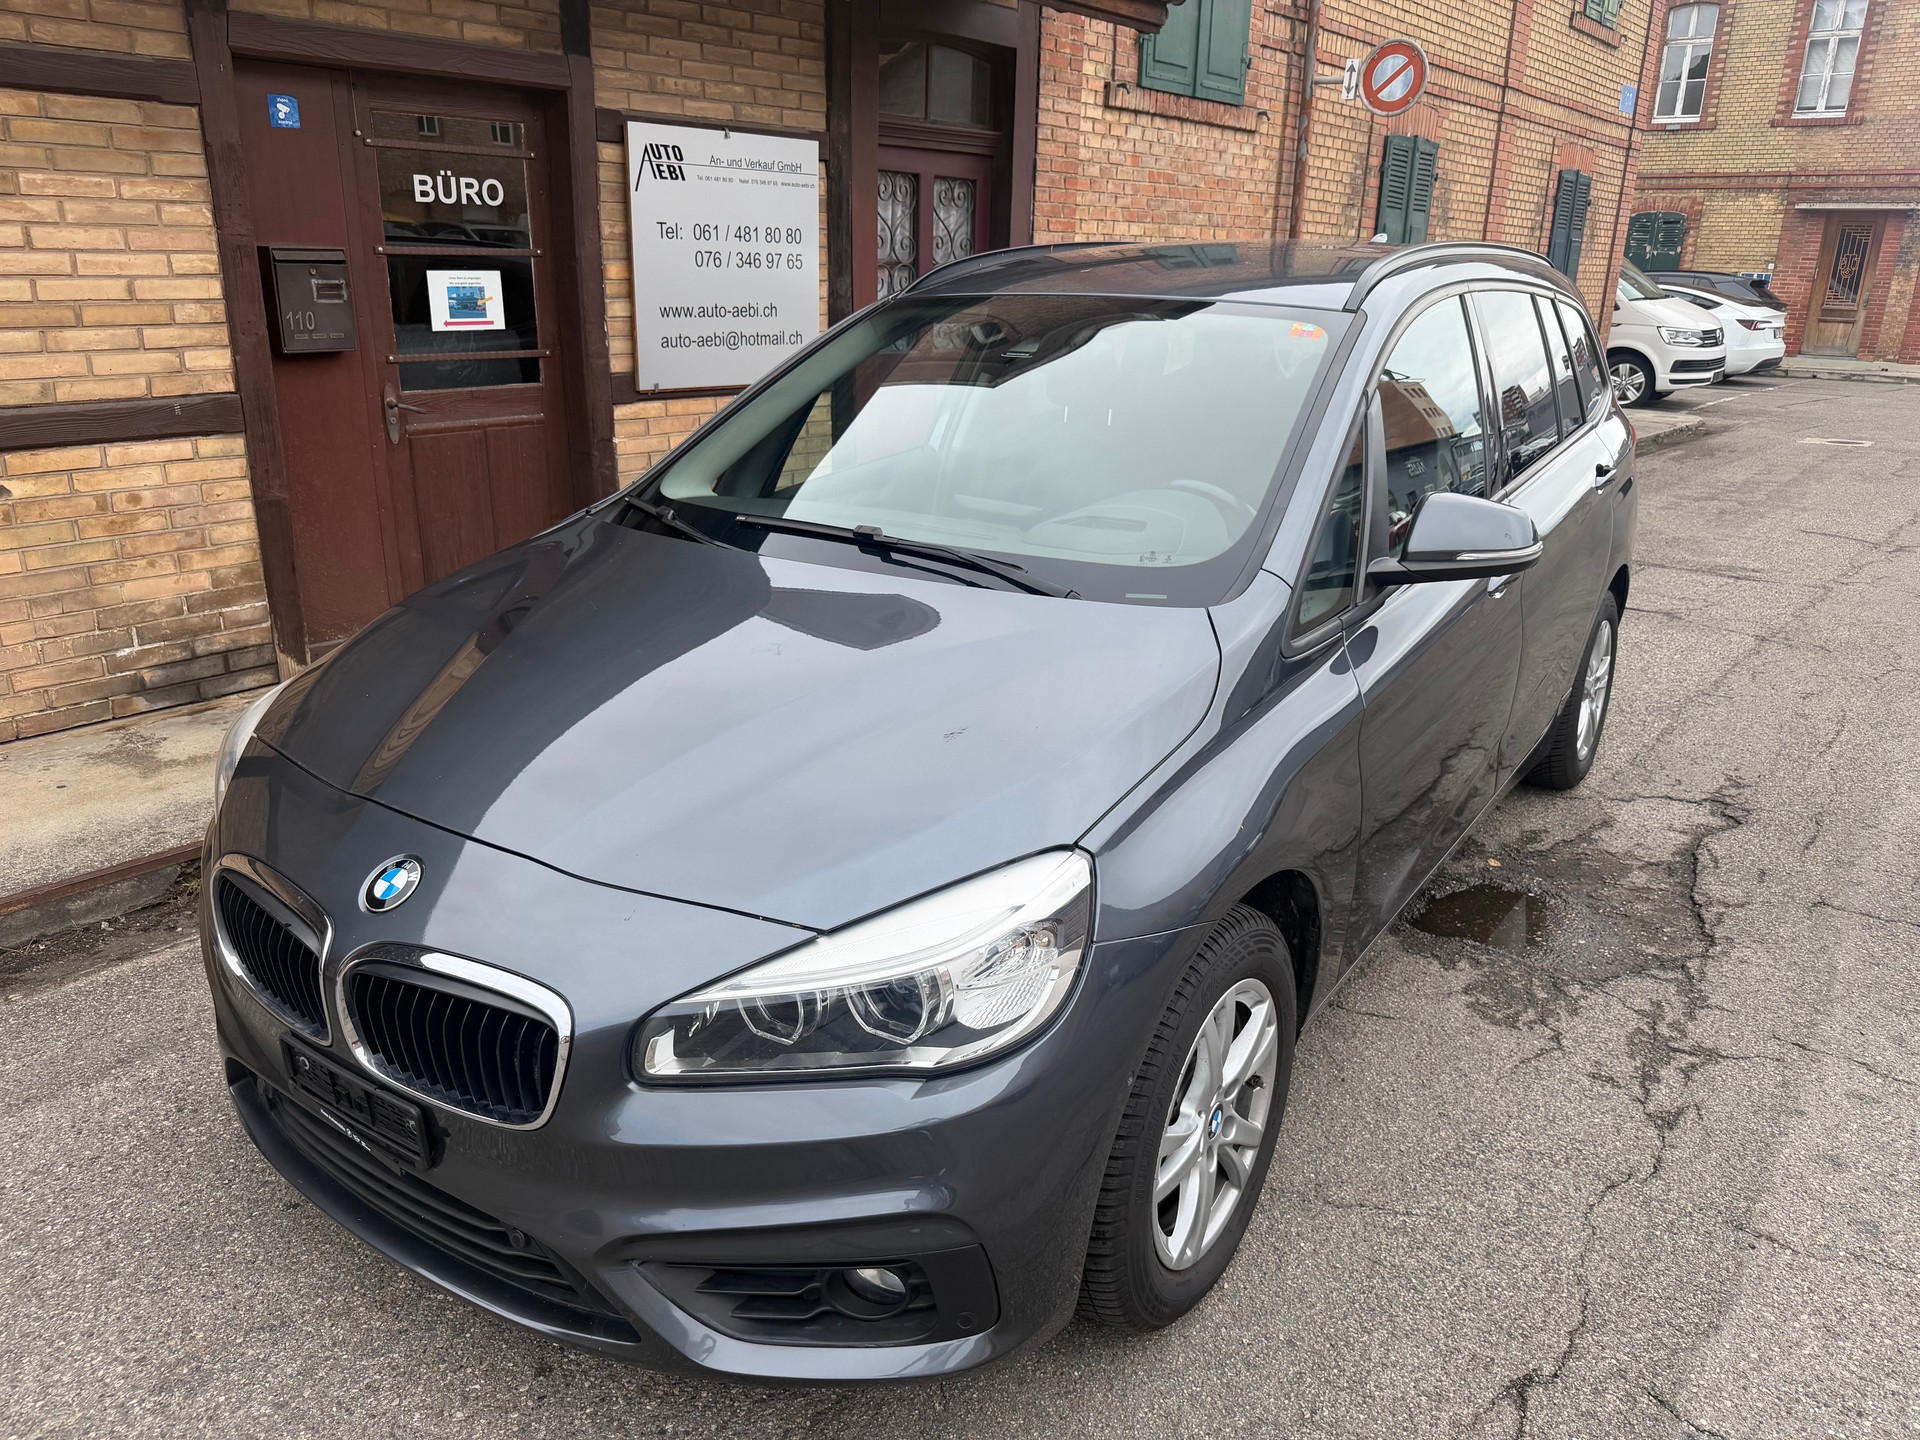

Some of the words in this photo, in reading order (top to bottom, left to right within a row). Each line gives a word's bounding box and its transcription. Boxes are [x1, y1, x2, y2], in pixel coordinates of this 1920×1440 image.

[709, 155, 725, 166] An-
[726, 158, 742, 168] und
[744, 158, 775, 170] Verkauf
[777, 161, 802, 172] GmbH
[413, 170, 505, 207] BÜRO
[656, 221, 683, 240] Tel:
[693, 223, 719, 241] 061
[724, 224, 730, 242] /
[734, 225, 759, 243] 481
[765, 227, 782, 244] 80
[786, 228, 802, 244] 80
[694, 250, 722, 268] 076
[726, 251, 732, 268] /
[735, 252, 762, 269] 346
[766, 253, 782, 269] 97
[786, 253, 803, 270] 65
[286, 311, 315, 330] 110
[659, 303, 778, 318] www.auto-aebi.ch
[660, 331, 803, 351] auto-aebi@hotmail.ch
